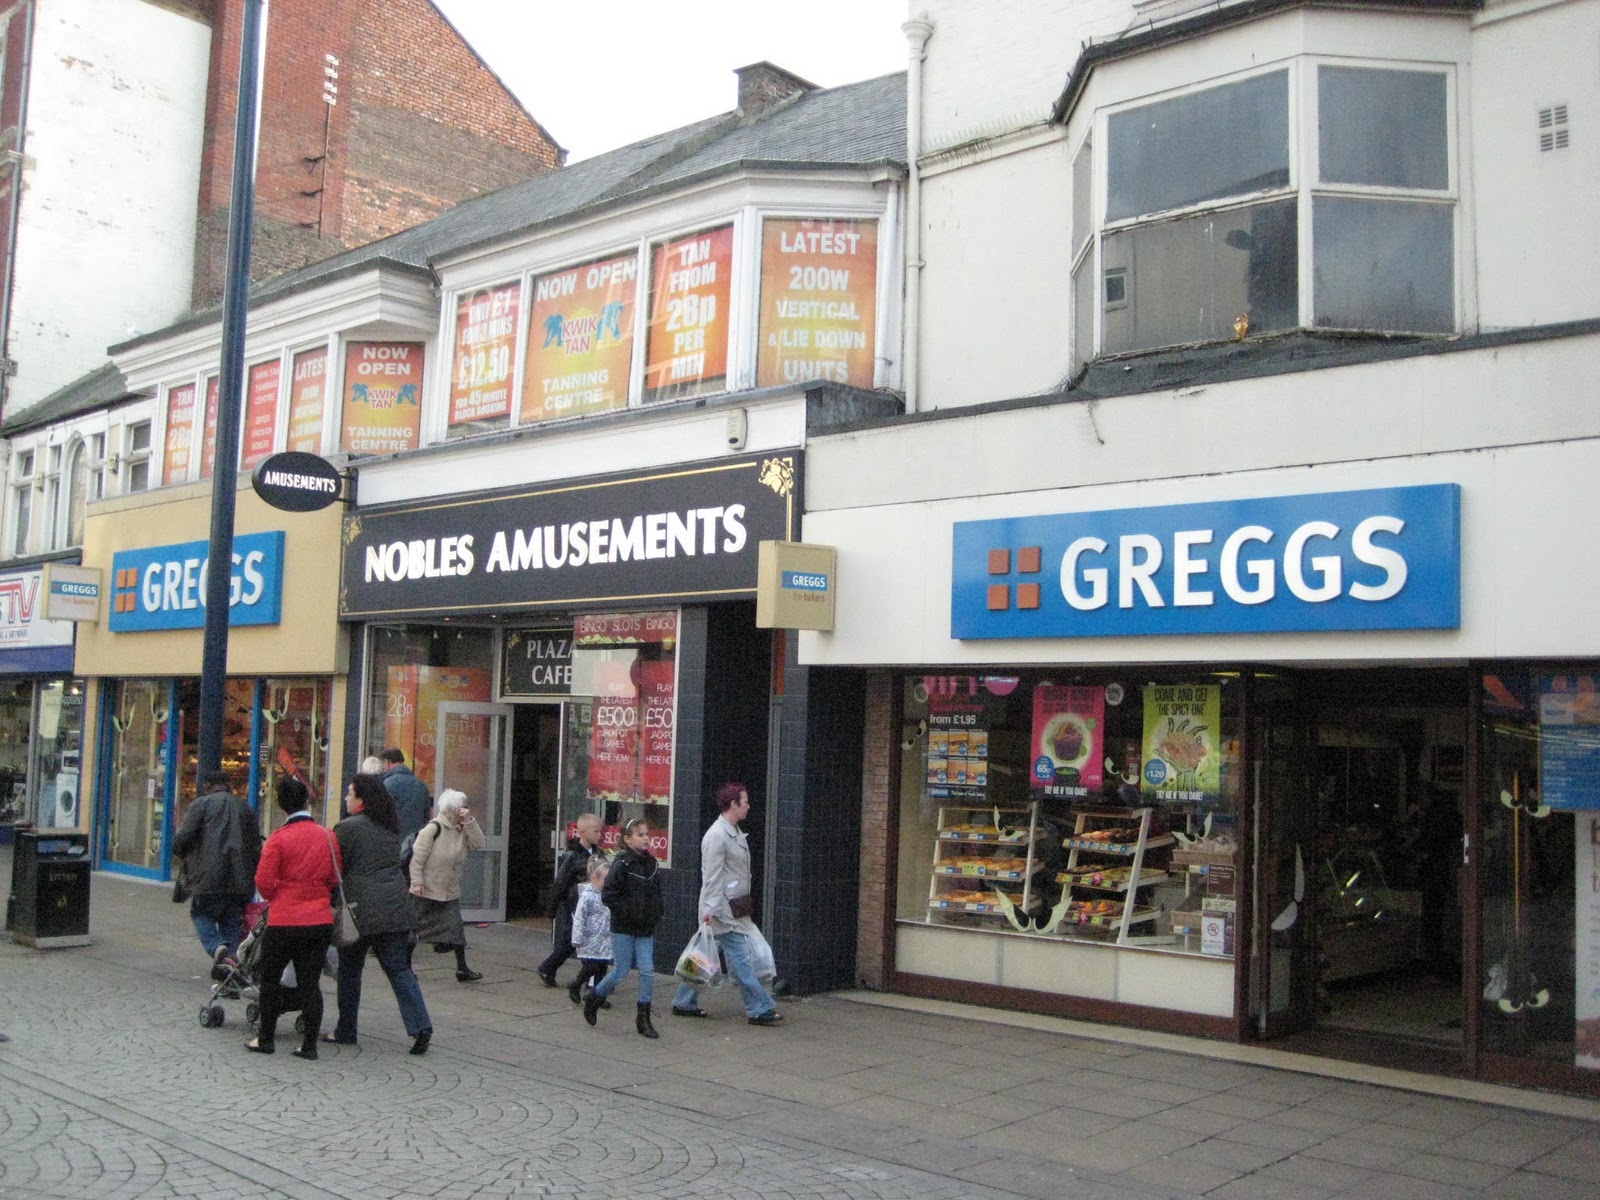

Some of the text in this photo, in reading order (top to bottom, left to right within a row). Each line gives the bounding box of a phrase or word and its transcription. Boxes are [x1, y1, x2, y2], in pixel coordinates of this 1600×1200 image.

[679, 239, 711, 266] TAN
[780, 232, 860, 255] LATEST
[537, 259, 637, 301] NOW OPEN
[670, 262, 716, 293] FROM
[789, 267, 850, 291] 200W
[665, 294, 717, 331] 28p
[776, 300, 860, 320] VERTICAL
[562, 315, 599, 336] KWIK
[565, 335, 592, 356] TAN
[674, 329, 705, 354] PER
[768, 329, 866, 349] & LIE DOWN
[362, 347, 409, 360] NOW
[295, 355, 328, 381] LATEST
[358, 363, 411, 375] OPEN
[458, 344, 509, 390] £12.50
[671, 353, 705, 380] MIN
[783, 359, 849, 383] UNITS
[542, 369, 609, 393] TANNING
[368, 389, 398, 399] KWIK
[544, 387, 604, 411] CENTRE
[371, 400, 393, 409] TAN
[348, 426, 413, 438] TANNING
[351, 440, 409, 450] CENTRE
[264, 471, 336, 493] AMUSEMENTS
[365, 504, 747, 583] NOBLES AMUSEMENTS
[1060, 515, 1408, 610] GREGGS
[61, 583, 97, 595] GREGGS
[792, 575, 826, 588] GREGGS
[804, 592, 826, 602] bakers
[580, 617, 675, 633] BINGO SLOTS BINGO
[527, 639, 579, 659] PLAZA
[531, 664, 572, 685] CAFE
[608, 683, 624, 692] PLAY
[656, 683, 673, 692] PLAY
[1154, 688, 1208, 702] COME AND GET
[387, 695, 413, 717] 28p
[611, 696, 633, 705] LATEST
[648, 696, 674, 706] THE LAT
[597, 706, 635, 727] £500
[645, 708, 673, 728] £50
[929, 714, 976, 725] from £1.95
[602, 728, 628, 738] JACKPOT
[650, 730, 673, 740] JACKPO
[604, 740, 625, 749] GAMES
[652, 741, 672, 751] GAME
[597, 751, 630, 762] HERE NOW
[645, 755, 672, 765] HERE NO
[604, 833, 621, 844] SLO
[649, 836, 668, 849] NGO
